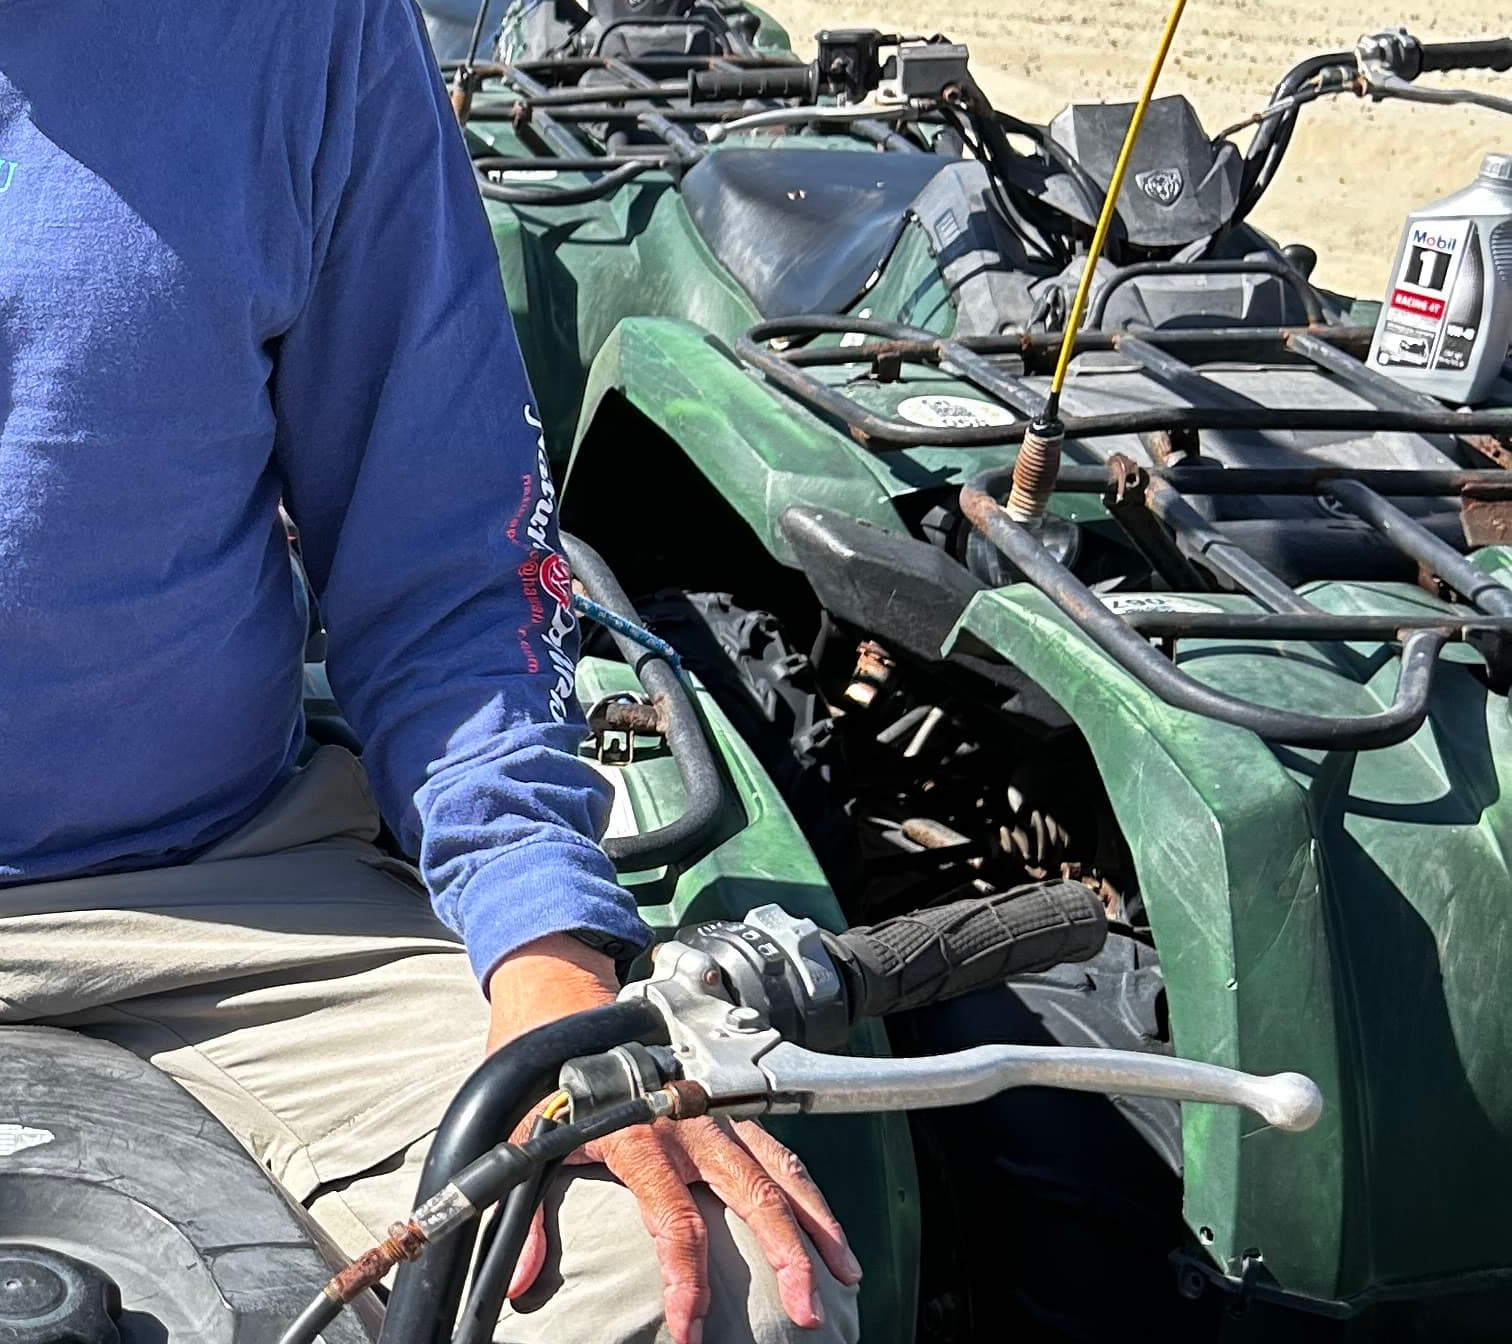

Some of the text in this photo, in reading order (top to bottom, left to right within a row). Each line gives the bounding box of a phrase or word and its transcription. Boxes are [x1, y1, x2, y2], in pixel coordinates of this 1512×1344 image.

[1413, 229, 1457, 251] Mobil
[1419, 250, 1438, 288] 1
[1395, 293, 1428, 311] RACING
